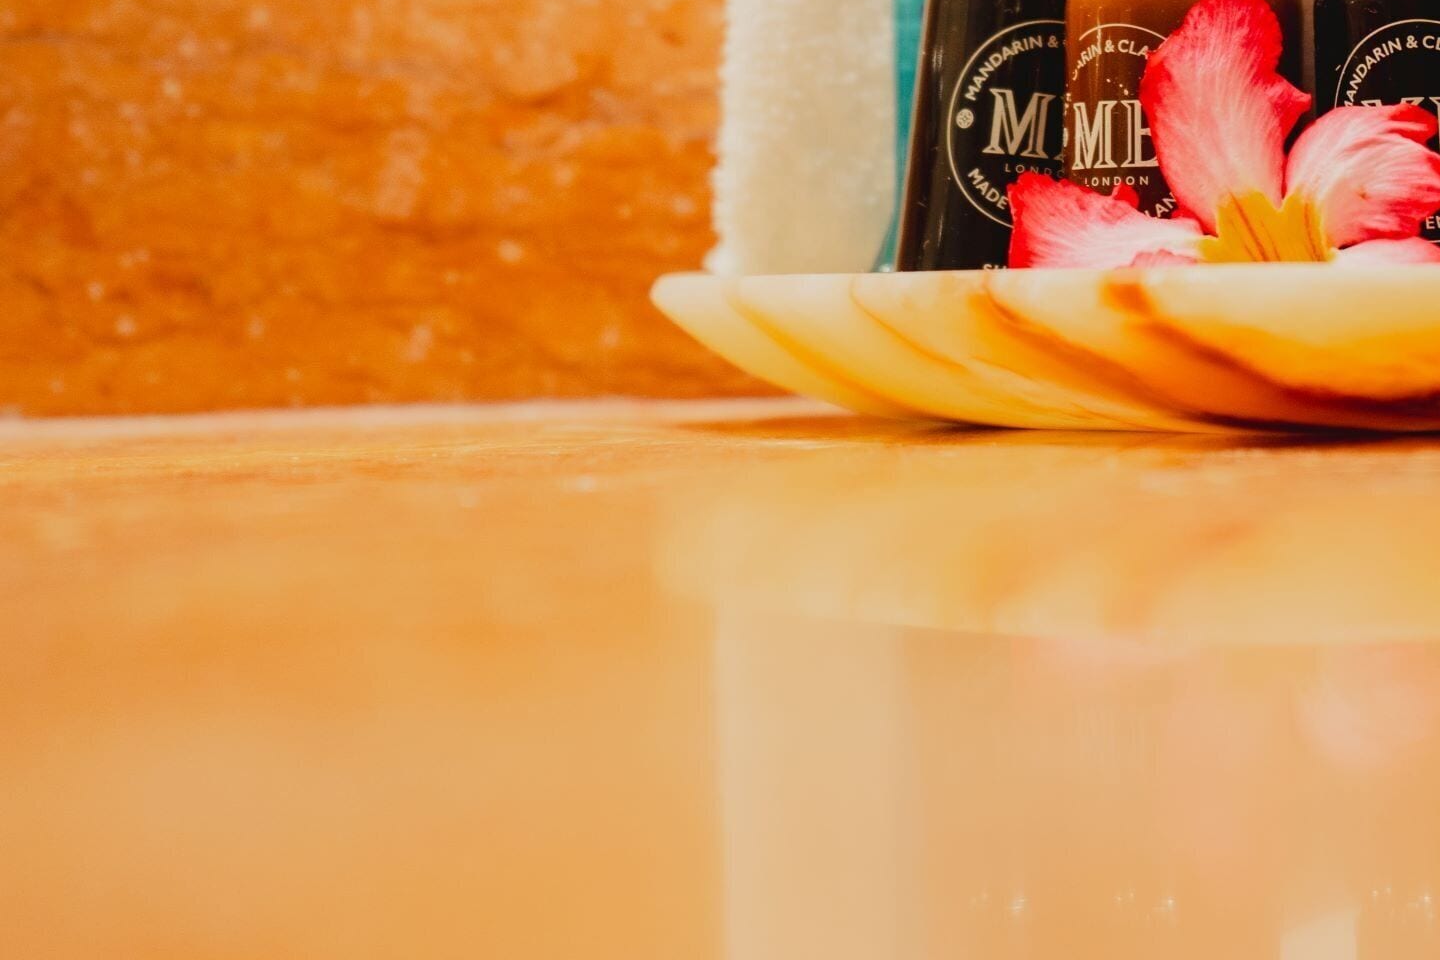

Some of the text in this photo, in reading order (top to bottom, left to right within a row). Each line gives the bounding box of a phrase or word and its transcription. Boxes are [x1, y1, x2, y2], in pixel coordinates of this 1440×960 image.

[1104, 39, 1115, 53] &
[1117, 39, 1149, 60] CLA
[1406, 35, 1419, 48] &
[965, 35, 1059, 101] MANDARIN &
[981, 88, 1064, 161] M
[1005, 163, 1065, 179] LONDO
[1084, 175, 1149, 187] LONDON
[968, 168, 1009, 210] MADE
